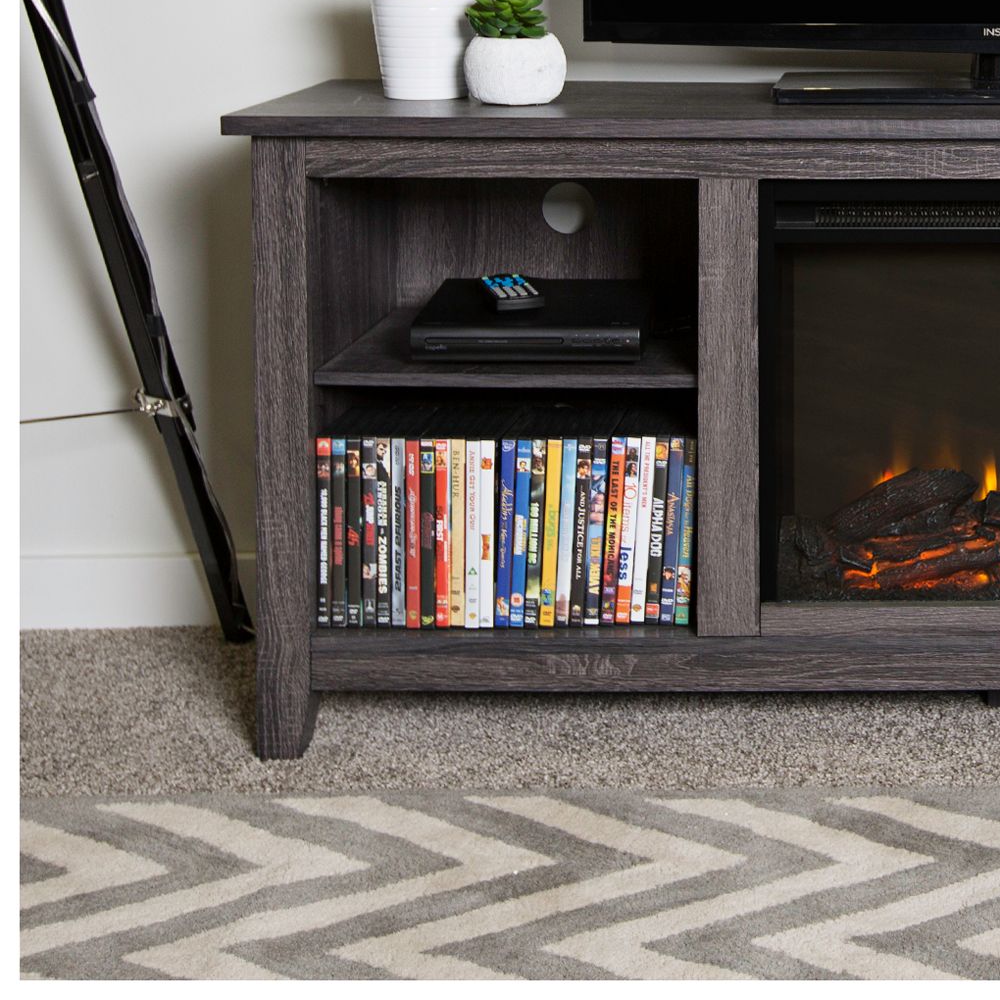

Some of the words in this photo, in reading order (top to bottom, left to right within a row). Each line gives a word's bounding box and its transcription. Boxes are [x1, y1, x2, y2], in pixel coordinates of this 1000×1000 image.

[501, 479, 516, 521] Aladdin
[611, 478, 619, 499] LAST
[624, 482, 637, 500] 10
[609, 514, 617, 530] THE
[610, 501, 618, 512] OF
[651, 497, 665, 534] ALPHA
[576, 507, 587, 549] JUSTICE
[606, 532, 616, 575] MOHICANS
[619, 546, 632, 580] less
[649, 535, 662, 558] DOG
[377, 536, 389, 594] ZOMBIES
